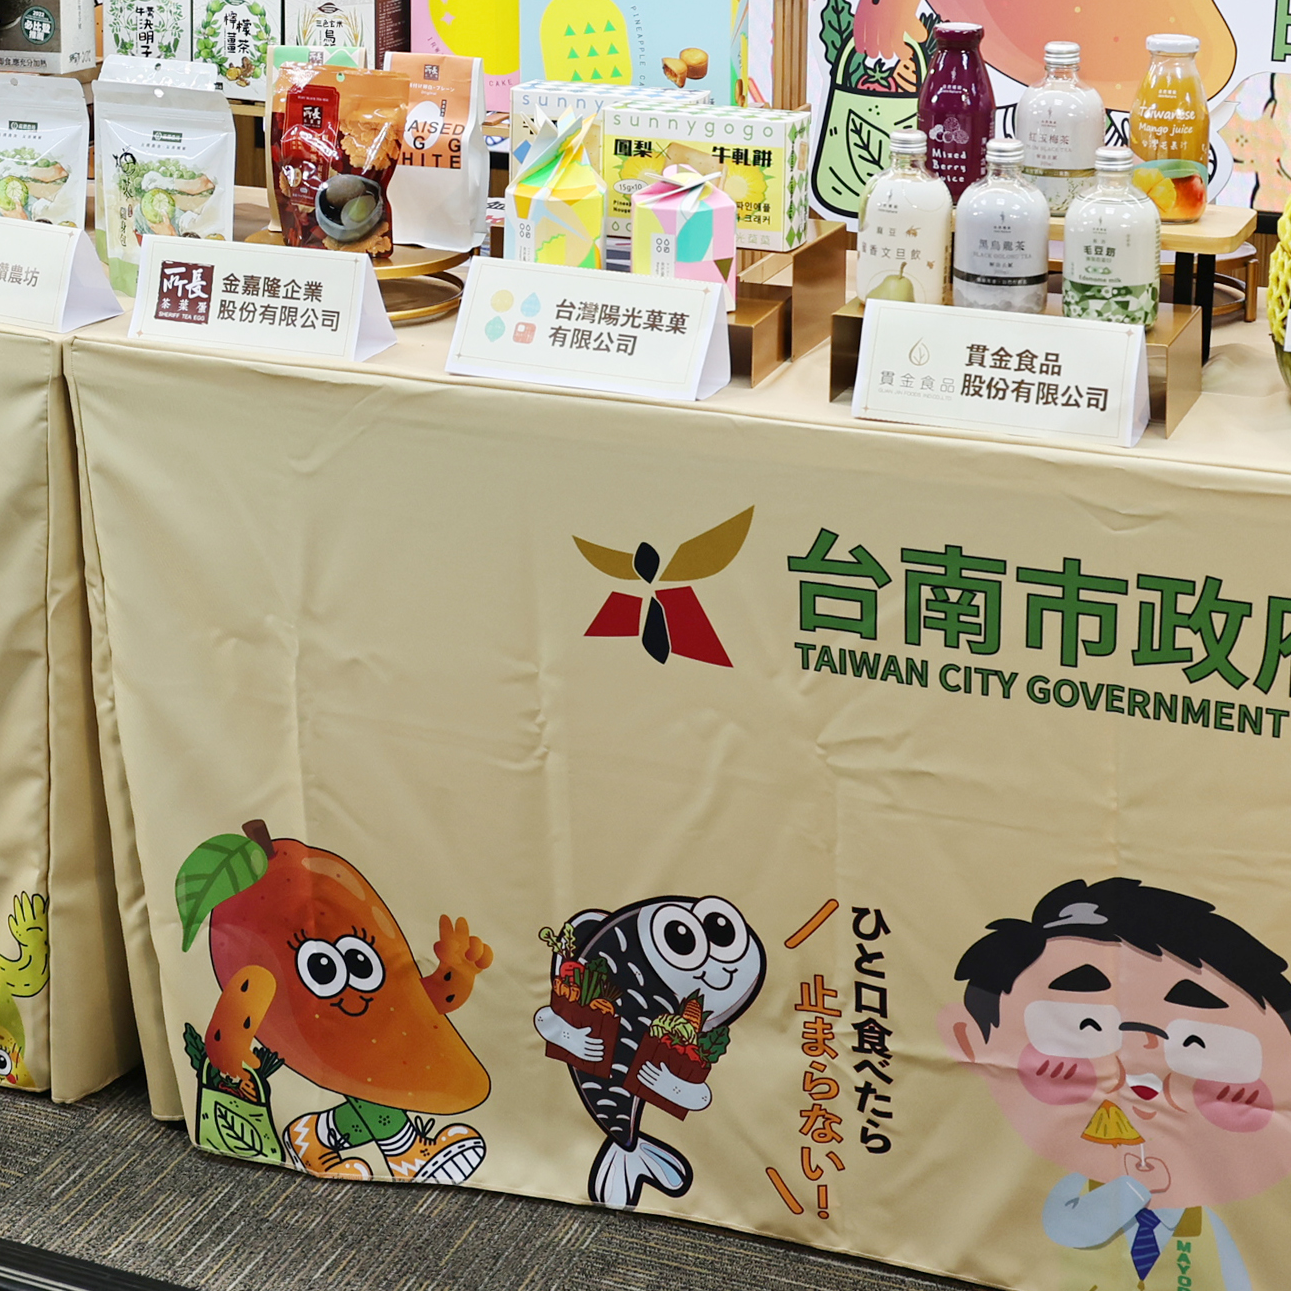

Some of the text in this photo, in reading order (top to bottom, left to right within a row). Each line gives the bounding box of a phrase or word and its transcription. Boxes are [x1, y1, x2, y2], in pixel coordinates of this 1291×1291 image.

[24, 20, 51, 33] 必比登
[489, 79, 513, 87] CAKE
[613, 112, 774, 141] sunnygogo
[1138, 122, 1193, 137] Mango juice
[402, 152, 462, 170] HITE
[613, 139, 653, 159] 鳳梨
[711, 145, 773, 168] 牛軋餅
[932, 148, 967, 159] Mixed
[933, 160, 967, 173] Berry
[163, 265, 210, 300] 所長
[220, 271, 324, 304] 金嘉隆企業
[158, 311, 206, 322] SHERIFF TEA EGG
[160, 297, 208, 315] 茶葉蛋
[217, 299, 341, 333] 股份有限公司
[554, 297, 690, 336] 台灣陽光菓菓
[547, 325, 639, 357] 有限公司
[964, 342, 1063, 377] 貫金食品
[879, 369, 956, 394] 貫金食品
[959, 372, 1109, 412] 股份有限公司
[795, 640, 930, 689] TAIWAN
[937, 661, 1020, 701] CITY
[1025, 672, 1291, 741] GOVERNMENT
[851, 906, 894, 1155] ひと口食べたら
